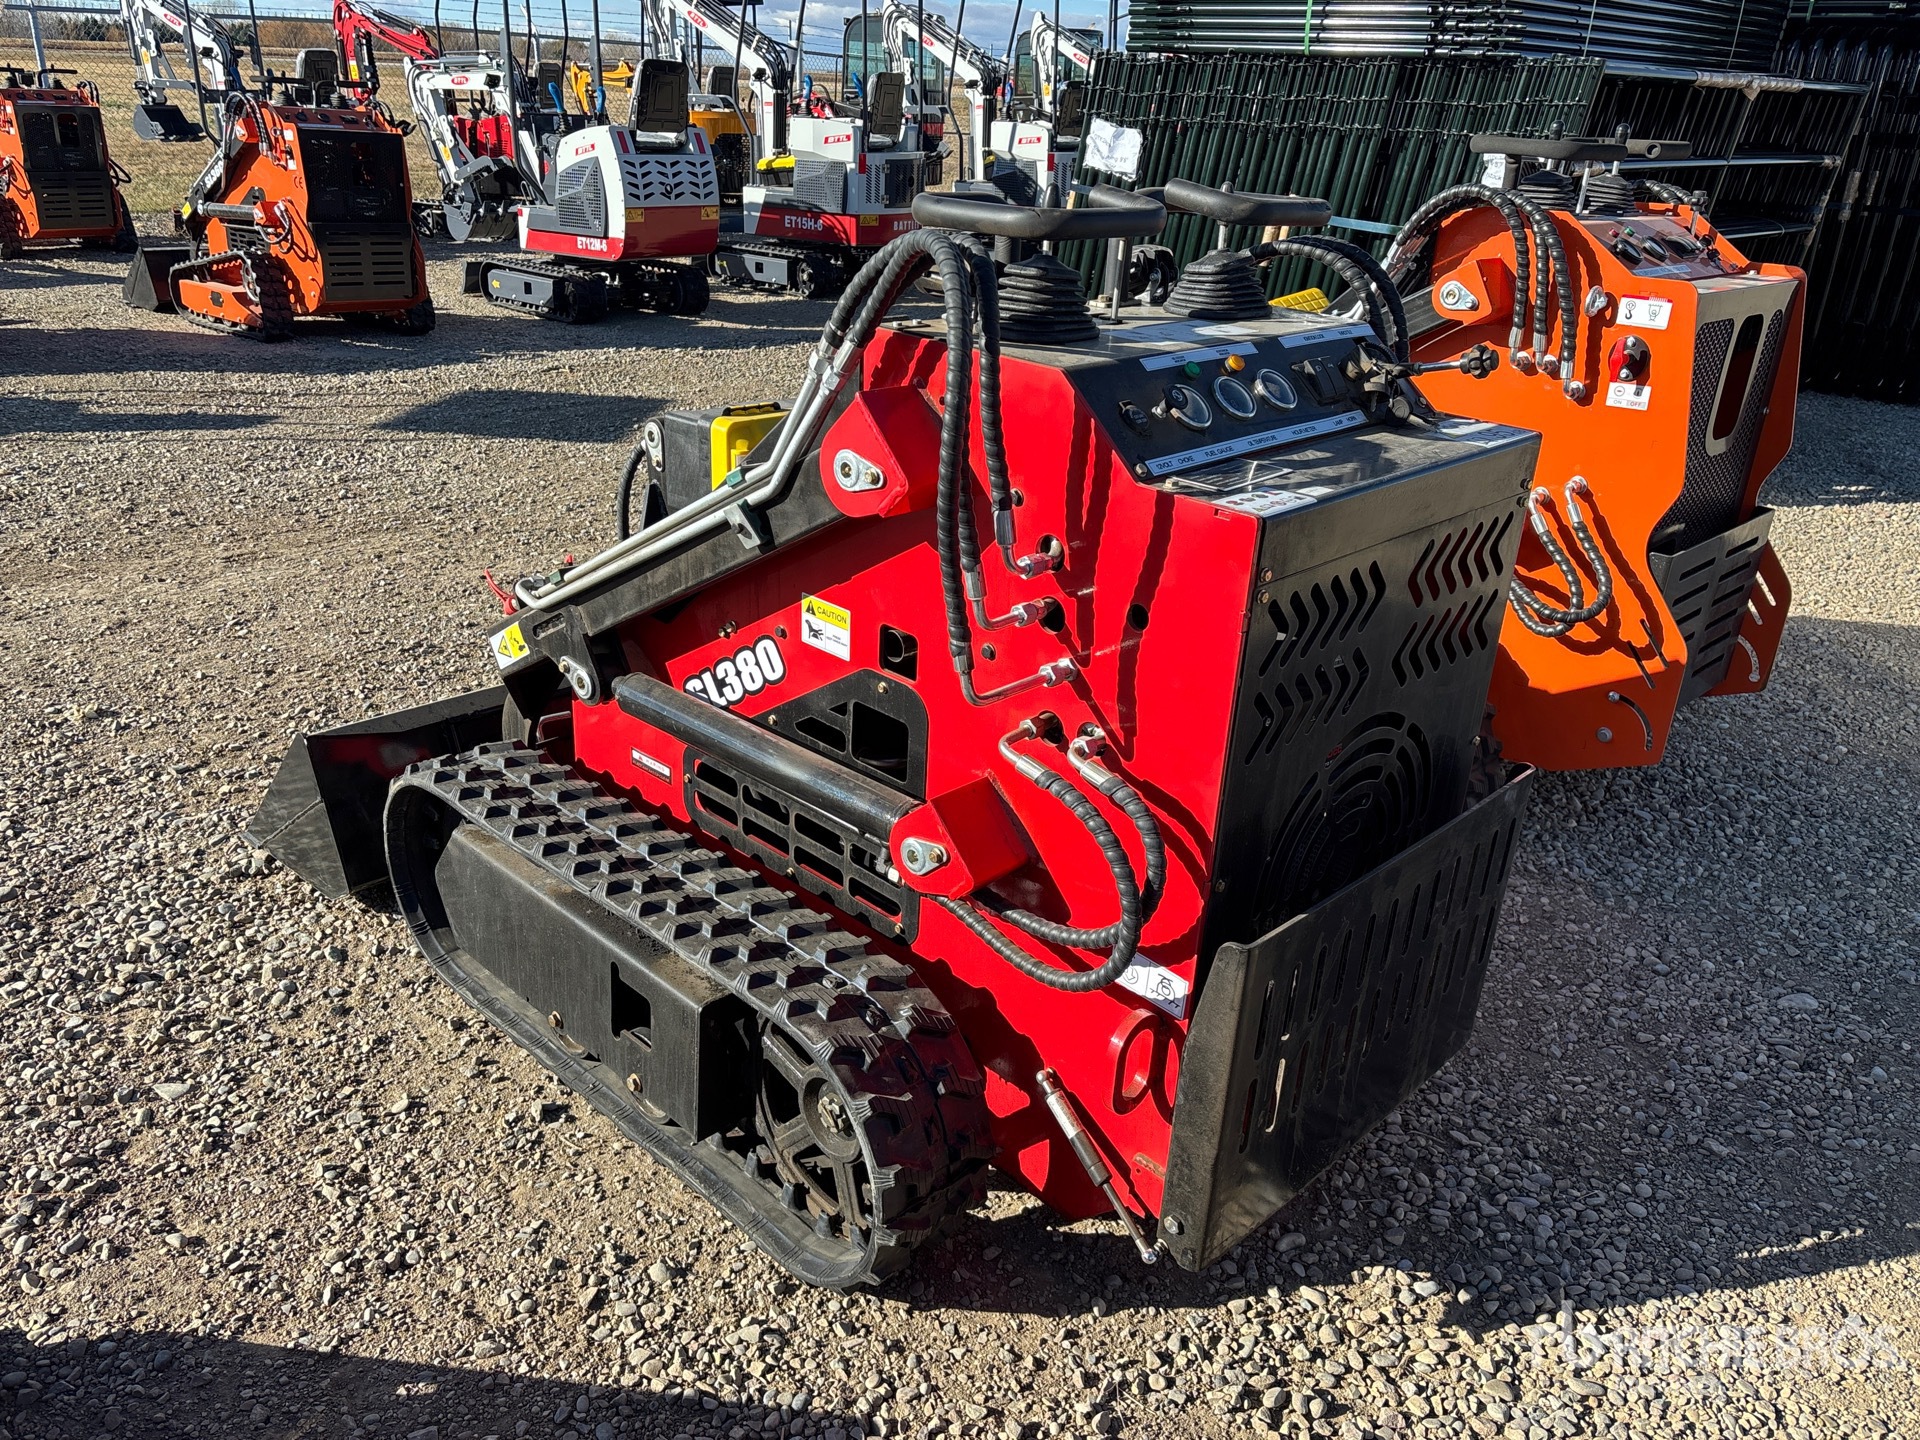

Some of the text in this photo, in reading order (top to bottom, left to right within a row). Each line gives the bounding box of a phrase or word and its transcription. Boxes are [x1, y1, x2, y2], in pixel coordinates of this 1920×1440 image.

[827, 135, 849, 143] BTTL
[784, 215, 823, 231] ET15H-6
[577, 236, 608, 252] ET12M-6
[1177, 455, 1195, 465] CHOKE
[816, 606, 847, 625] CAUTION
[684, 637, 785, 707] SL380
